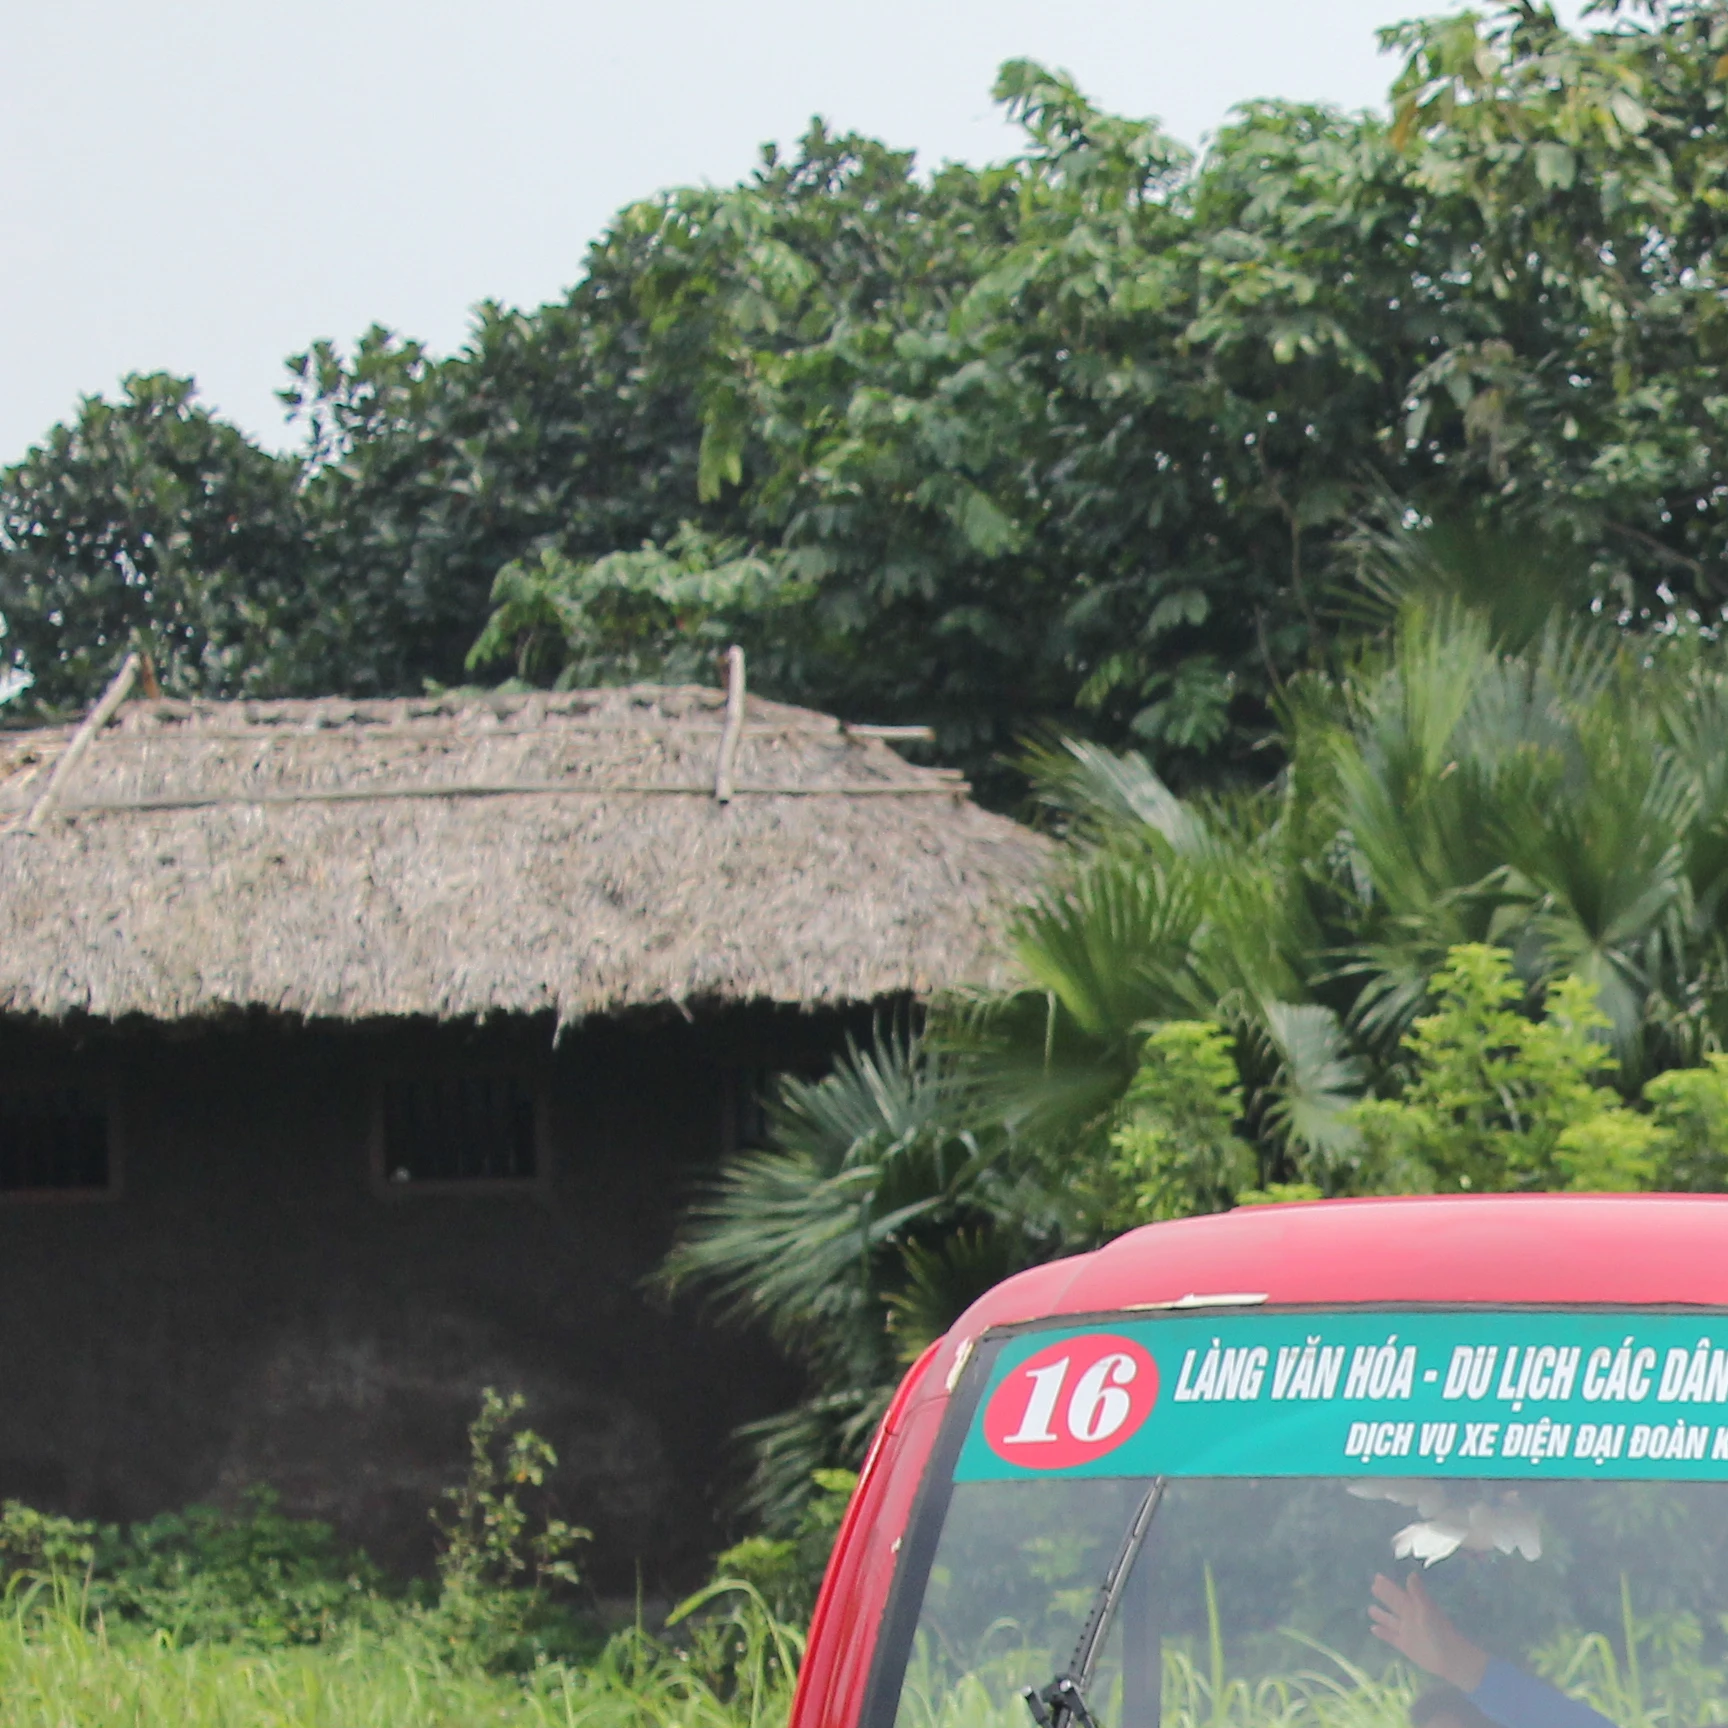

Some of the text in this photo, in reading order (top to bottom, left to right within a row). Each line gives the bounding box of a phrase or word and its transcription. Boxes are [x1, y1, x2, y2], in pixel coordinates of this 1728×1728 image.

[1003, 1353, 1137, 1444] 16
[1174, 1337, 1267, 1401] LÀNG
[1270, 1335, 1345, 1400] VĂN
[1343, 1334, 1417, 1400] HÓA
[1442, 1346, 1498, 1399] DU
[1496, 1346, 1581, 1412] LỊCH
[1582, 1336, 1656, 1402] CÁC
[1344, 1421, 1415, 1462] DỊCH
[1418, 1422, 1458, 1464] VỤ
[1457, 1423, 1500, 1457] XE
[1501, 1416, 1573, 1465] ĐIỆN
[1573, 1424, 1627, 1465] ĐẠI
[1627, 1418, 1710, 1460] ĐOÀN
